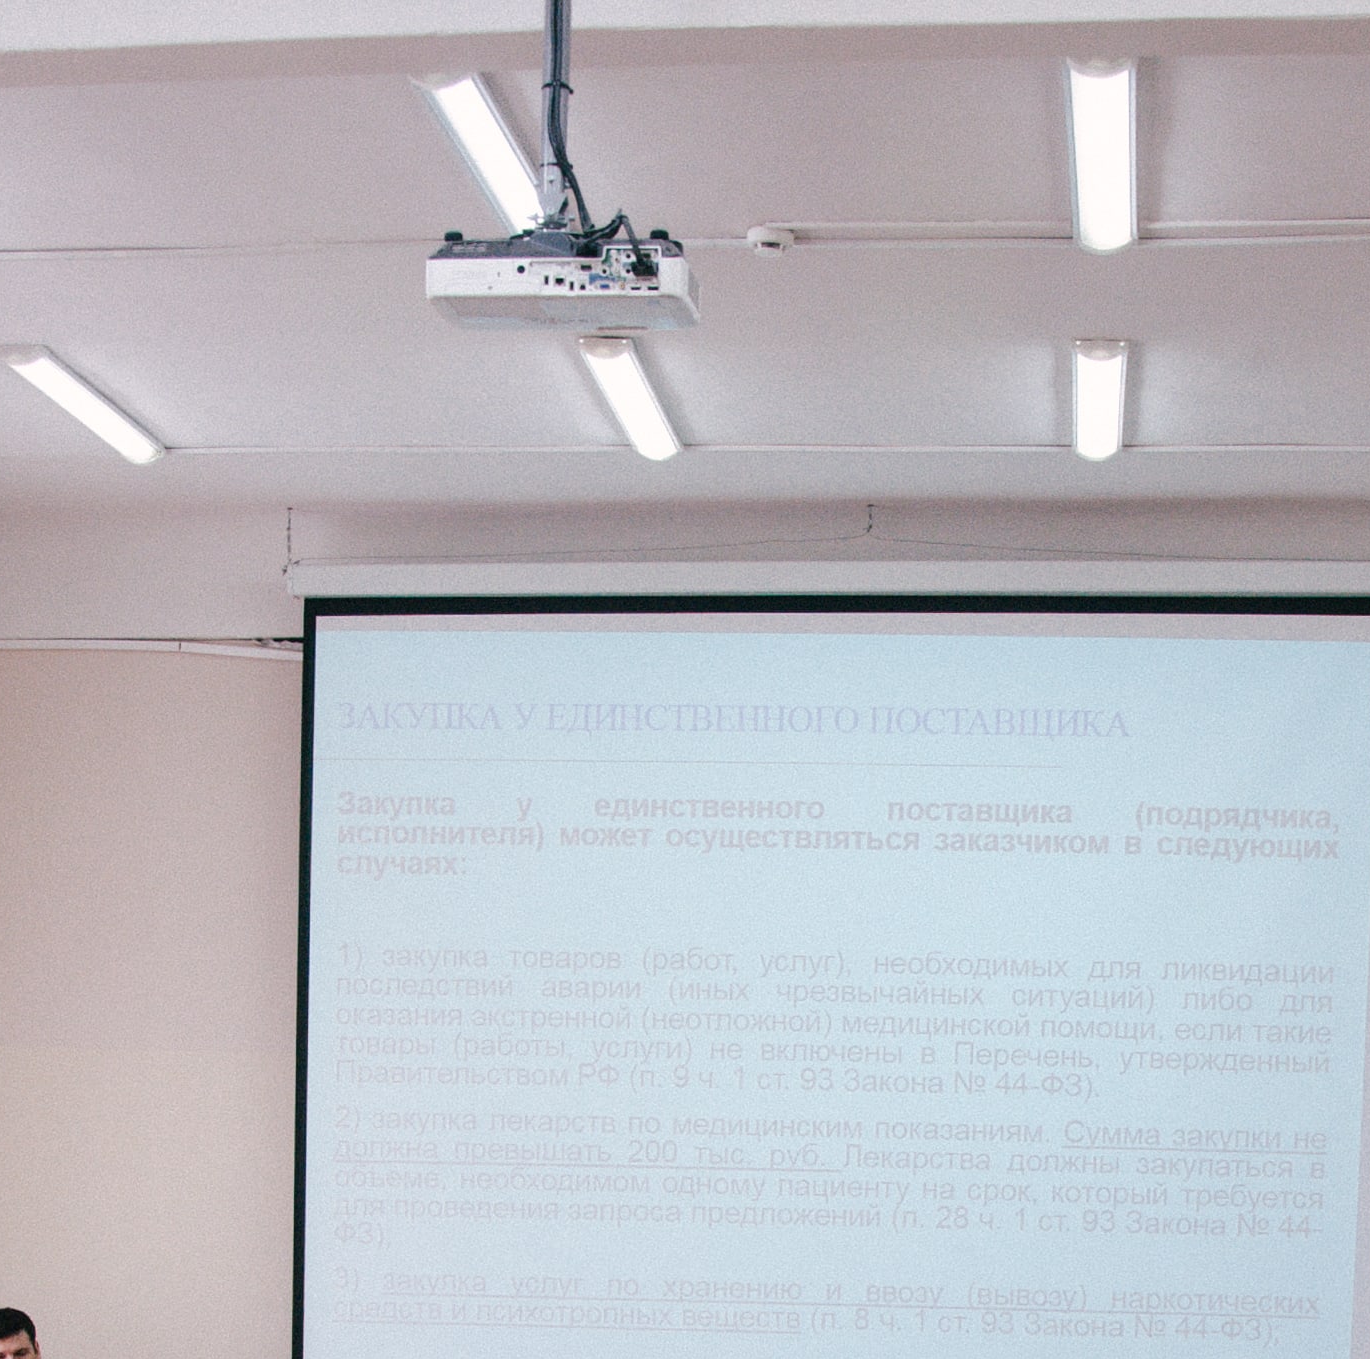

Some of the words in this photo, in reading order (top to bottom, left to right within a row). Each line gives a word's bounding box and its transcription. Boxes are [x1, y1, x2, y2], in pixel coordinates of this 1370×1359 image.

[336, 699, 503, 730] ЗАКУПКА
[513, 701, 538, 730] У
[546, 702, 860, 738] ЕДИНСТВЕННОГО
[870, 706, 1131, 742] ПОСТАВЩИКА
[336, 789, 457, 821] Закупка
[516, 797, 534, 822] у
[593, 798, 825, 824] единственного
[886, 802, 1073, 827] поставщика
[1134, 800, 1341, 833] (подрядчика,
[336, 818, 545, 852] исполнителя)
[558, 827, 653, 847] может
[665, 829, 921, 857] осуществляться
[932, 832, 1110, 854] заказчиком
[1123, 835, 1142, 854] в
[1156, 836, 1340, 863] следующих
[336, 854, 467, 881] случаях:
[336, 941, 364, 972] 1)
[381, 947, 489, 974] закупка
[508, 949, 622, 976] товаров
[641, 946, 739, 978] (работ,
[759, 948, 852, 980] услуг),
[873, 950, 1069, 981] необходимых
[1160, 960, 1335, 986] ликвидации
[336, 971, 514, 1001] последствий
[540, 980, 642, 1006] аварии
[668, 976, 750, 1007] (иных
[776, 978, 985, 1011] чрезвычайных
[1011, 982, 1156, 1014] ситуаций)
[1181, 985, 1253, 1010] либо
[336, 1006, 463, 1026] оказания
[471, 1003, 632, 1035] экстренной
[640, 1006, 834, 1039] (неотложной)
[841, 1009, 1031, 1040] медицинской
[1040, 1018, 1164, 1043] помощи,
[1174, 1021, 1243, 1040] если
[1252, 1022, 1332, 1042] такие
[336, 1035, 438, 1061] товары
[452, 1032, 574, 1064] (работы,
[590, 1034, 694, 1066] услуги)
[709, 1042, 744, 1061] не
[760, 1043, 903, 1064] включены
[919, 1045, 936, 1064] в
[954, 1041, 1101, 1073] Перечень,
[1119, 1043, 1330, 1077] утвержденный
[335, 1059, 569, 1092] Правительством
[577, 1063, 621, 1087] РФ
[629, 1064, 663, 1094] (п.
[672, 1065, 690, 1089] 9
[697, 1071, 719, 1089] ч.
[732, 1066, 745, 1090] 1
[756, 1073, 790, 1091] ст.
[799, 1067, 835, 1091] 93
[844, 1068, 945, 1093] Закона
[953, 1070, 987, 1094] №
[994, 1070, 1101, 1102] 44-ФЗ).
[333, 1104, 362, 1135] 2)
[371, 1111, 478, 1137] закупка
[489, 1113, 616, 1139] лекарств
[627, 1116, 661, 1134] по
[672, 1117, 863, 1142] медицинским
[874, 1121, 1051, 1142] показаниям.
[1062, 1118, 1161, 1150] Сумма
[1171, 1126, 1282, 1152] закупки
[1293, 1128, 1328, 1147] не
[333, 1140, 439, 1163] должна
[454, 1142, 613, 1169] превышать
[627, 1139, 679, 1164] 200
[695, 1147, 755, 1165] тыс.
[769, 1142, 826, 1173] руб.
[843, 1143, 992, 1176] Лекарства
[1006, 1153, 1120, 1176] должны
[1134, 1155, 1294, 1182] закупаться
[1309, 1159, 1325, 1176] в
[459, 1166, 650, 1197] необходимом
[661, 1176, 766, 1202] одному
[777, 1179, 910, 1205] пациенту
[921, 1182, 956, 1200] на
[966, 1182, 1039, 1207] срок,
[1050, 1178, 1169, 1210] который
[1181, 1180, 1324, 1213] требуется
[393, 1200, 560, 1226] проведения
[567, 1203, 682, 1229] запроса
[691, 1199, 882, 1233] предложений
[891, 1203, 925, 1234] (п.
[935, 1204, 970, 1229] 28
[978, 1211, 1001, 1229] ч.
[1014, 1206, 1027, 1230] 1
[1037, 1213, 1071, 1231] ст.
[1082, 1207, 1117, 1232] 93
[1125, 1208, 1227, 1234] Закона
[1236, 1210, 1270, 1235] №
[381, 1274, 487, 1300] закупка
[509, 1277, 585, 1302] услуг
[606, 1279, 639, 1297] по
[661, 1280, 803, 1307] хранению
[824, 1283, 842, 1301] и
[865, 1284, 945, 1310] ввозу
[967, 1281, 1089, 1313] (вывозу)
[1110, 1289, 1320, 1318] наркотических
[451, 1303, 467, 1322] и
[476, 1304, 672, 1332] психотропных
[682, 1308, 802, 1333] веществ
[809, 1306, 844, 1336] (п.
[853, 1307, 870, 1331] 8
[879, 1313, 902, 1331] ч.
[915, 1308, 927, 1332] 1
[936, 1314, 971, 1333] ст.
[980, 1309, 1015, 1334] 93
[1023, 1310, 1125, 1336] Закона
[1133, 1313, 1167, 1337] №
